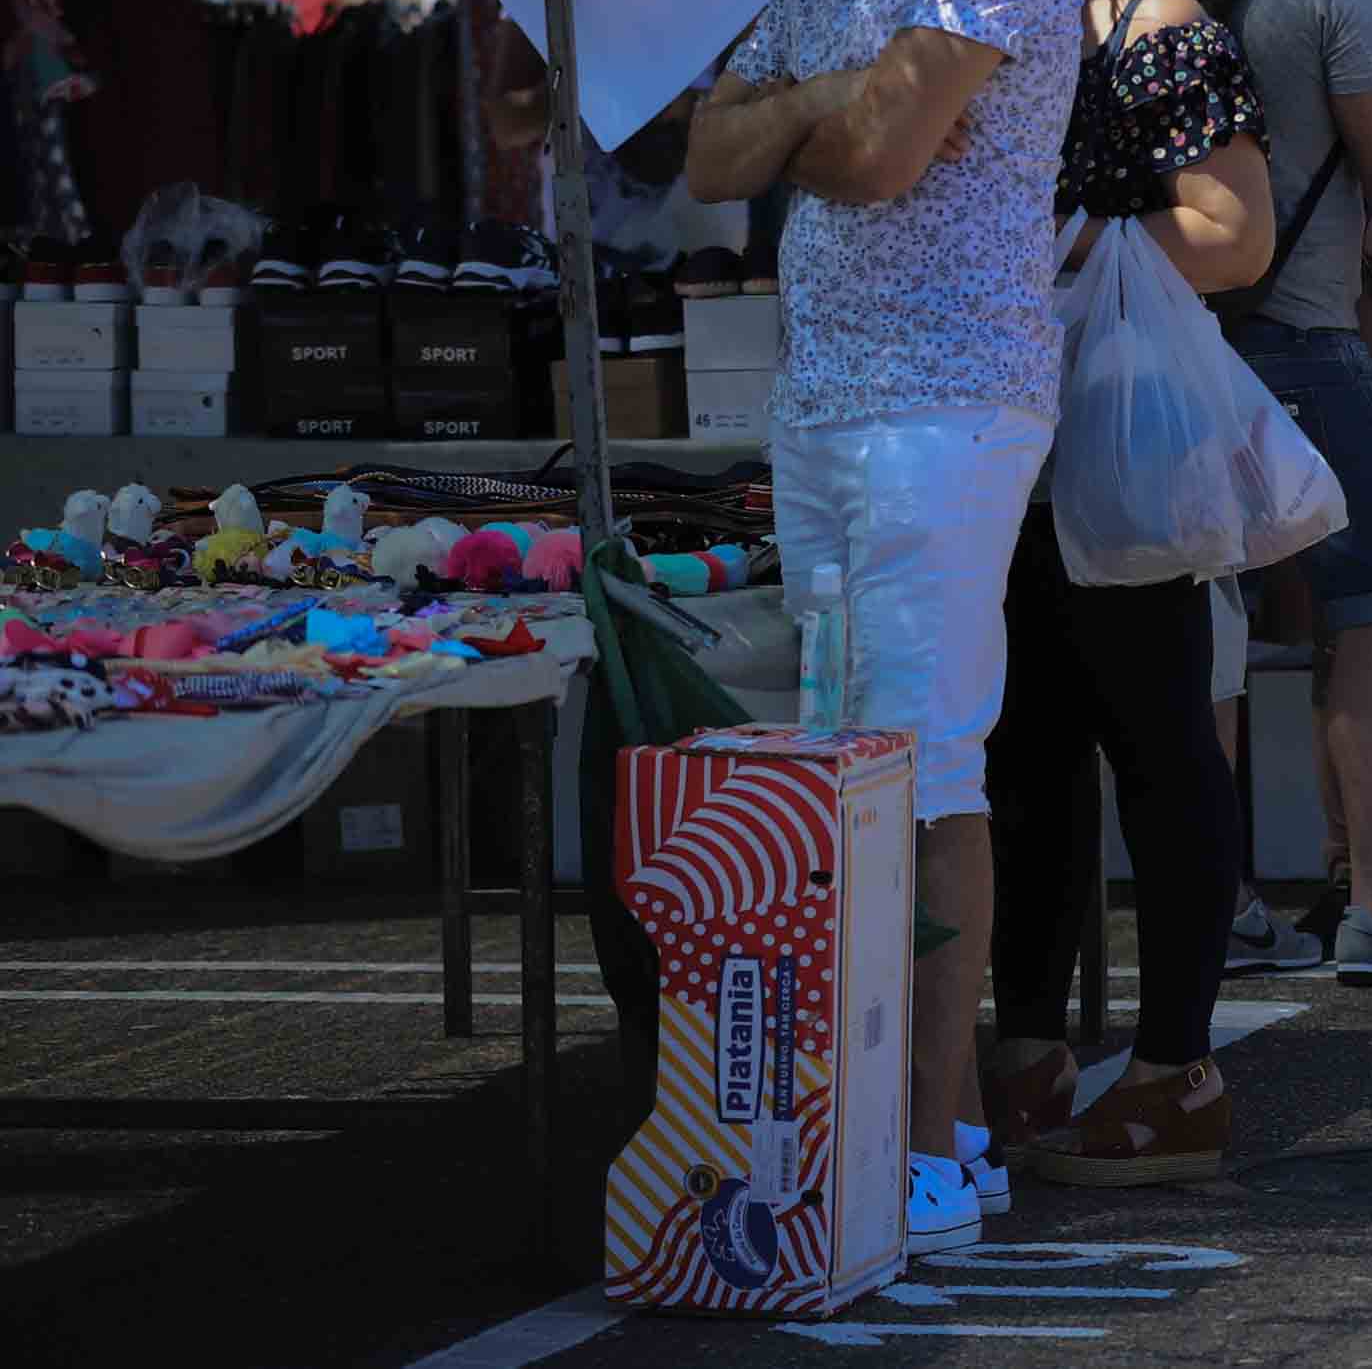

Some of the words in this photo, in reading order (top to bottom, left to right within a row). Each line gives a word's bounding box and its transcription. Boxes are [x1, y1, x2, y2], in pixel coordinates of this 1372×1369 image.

[290, 344, 349, 362] SPORT
[419, 345, 478, 363] SPORT
[295, 419, 353, 435] SPORT
[423, 420, 481, 436] SPORT
[726, 969, 754, 1111] Platania
